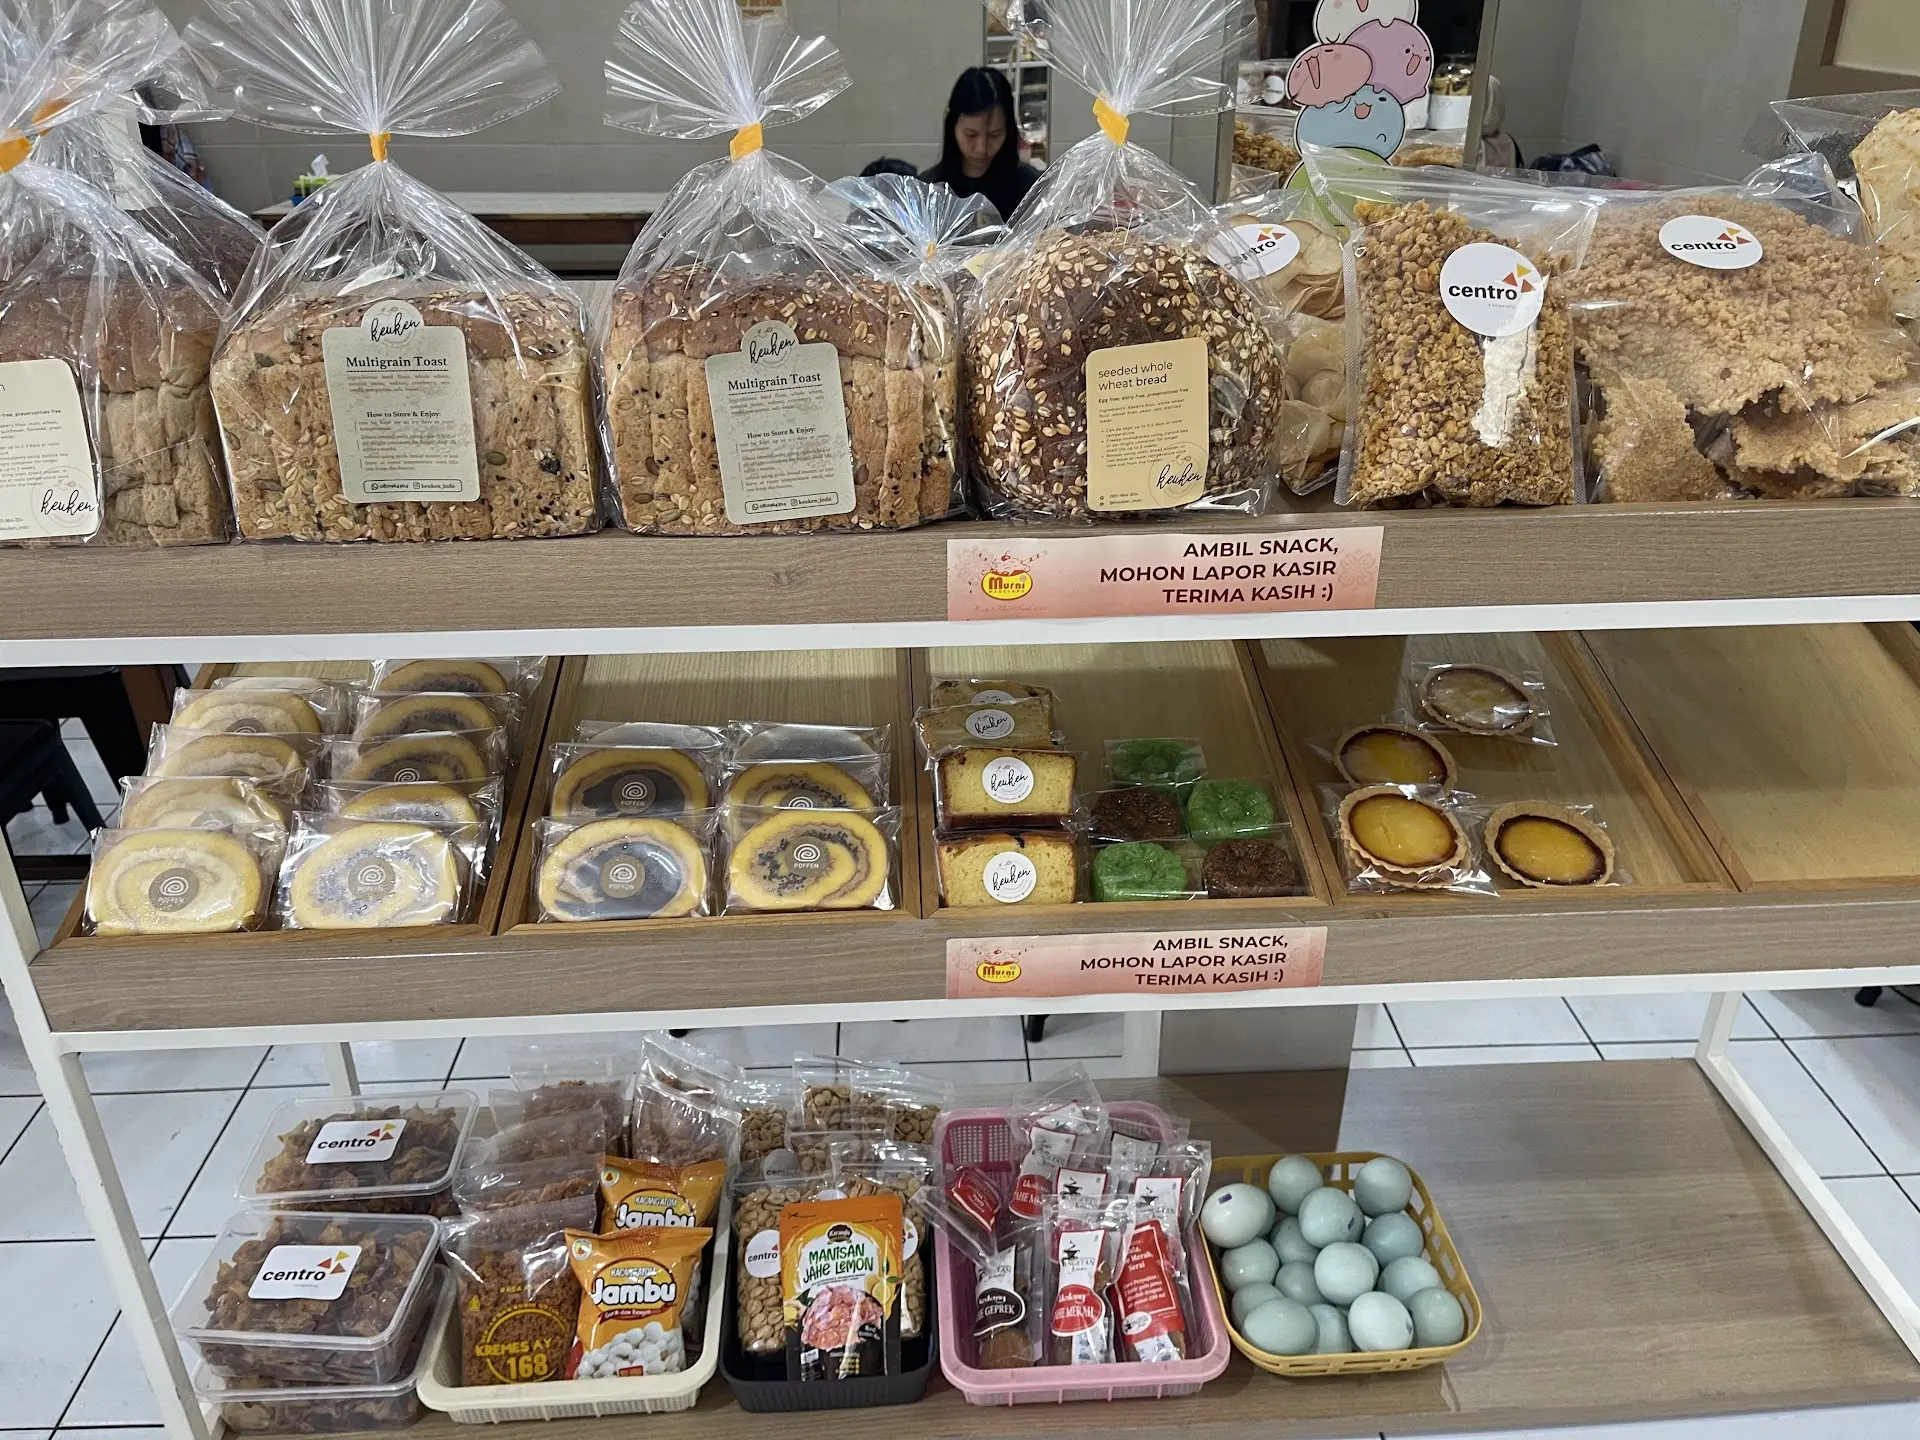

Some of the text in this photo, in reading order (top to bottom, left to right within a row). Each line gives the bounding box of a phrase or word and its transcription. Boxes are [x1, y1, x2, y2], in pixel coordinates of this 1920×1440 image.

[1671, 242, 1737, 251] centro
[1448, 285, 1518, 300] centro
[370, 312, 420, 342] keuken
[750, 332, 796, 364] keuken
[346, 356, 448, 370] Multigrain Toast
[1098, 361, 1173, 378] seeded whole
[728, 372, 822, 391] Multigrain Toast
[1098, 374, 1167, 390] wheat bread
[1156, 462, 1203, 490] keuken
[40, 488, 96, 516] keuken
[1184, 537, 1339, 558] AMBIL SNACK,
[1100, 560, 1336, 583] MOHON LAPOR KASIR
[989, 577, 1025, 590] Murni
[1163, 583, 1334, 604] TERIMA KASIH :)
[974, 716, 1008, 734] keuken
[990, 769, 1028, 792] keuken
[992, 865, 1031, 891] keuken
[1152, 935, 1288, 951] AMBIL SNACK,
[1080, 952, 1286, 971] MOHON LAPOR KASIR
[983, 966, 1014, 976] Murni
[1134, 968, 1284, 986] TERIMA KASIH :)
[318, 1138, 376, 1149] centro
[748, 1251, 778, 1262] centro
[262, 1268, 326, 1281] centro
[590, 1277, 677, 1306] Jambu
[984, 1304, 1015, 1316] GEPREK
[475, 1341, 530, 1357] KREMES
[506, 1353, 548, 1380] 168
